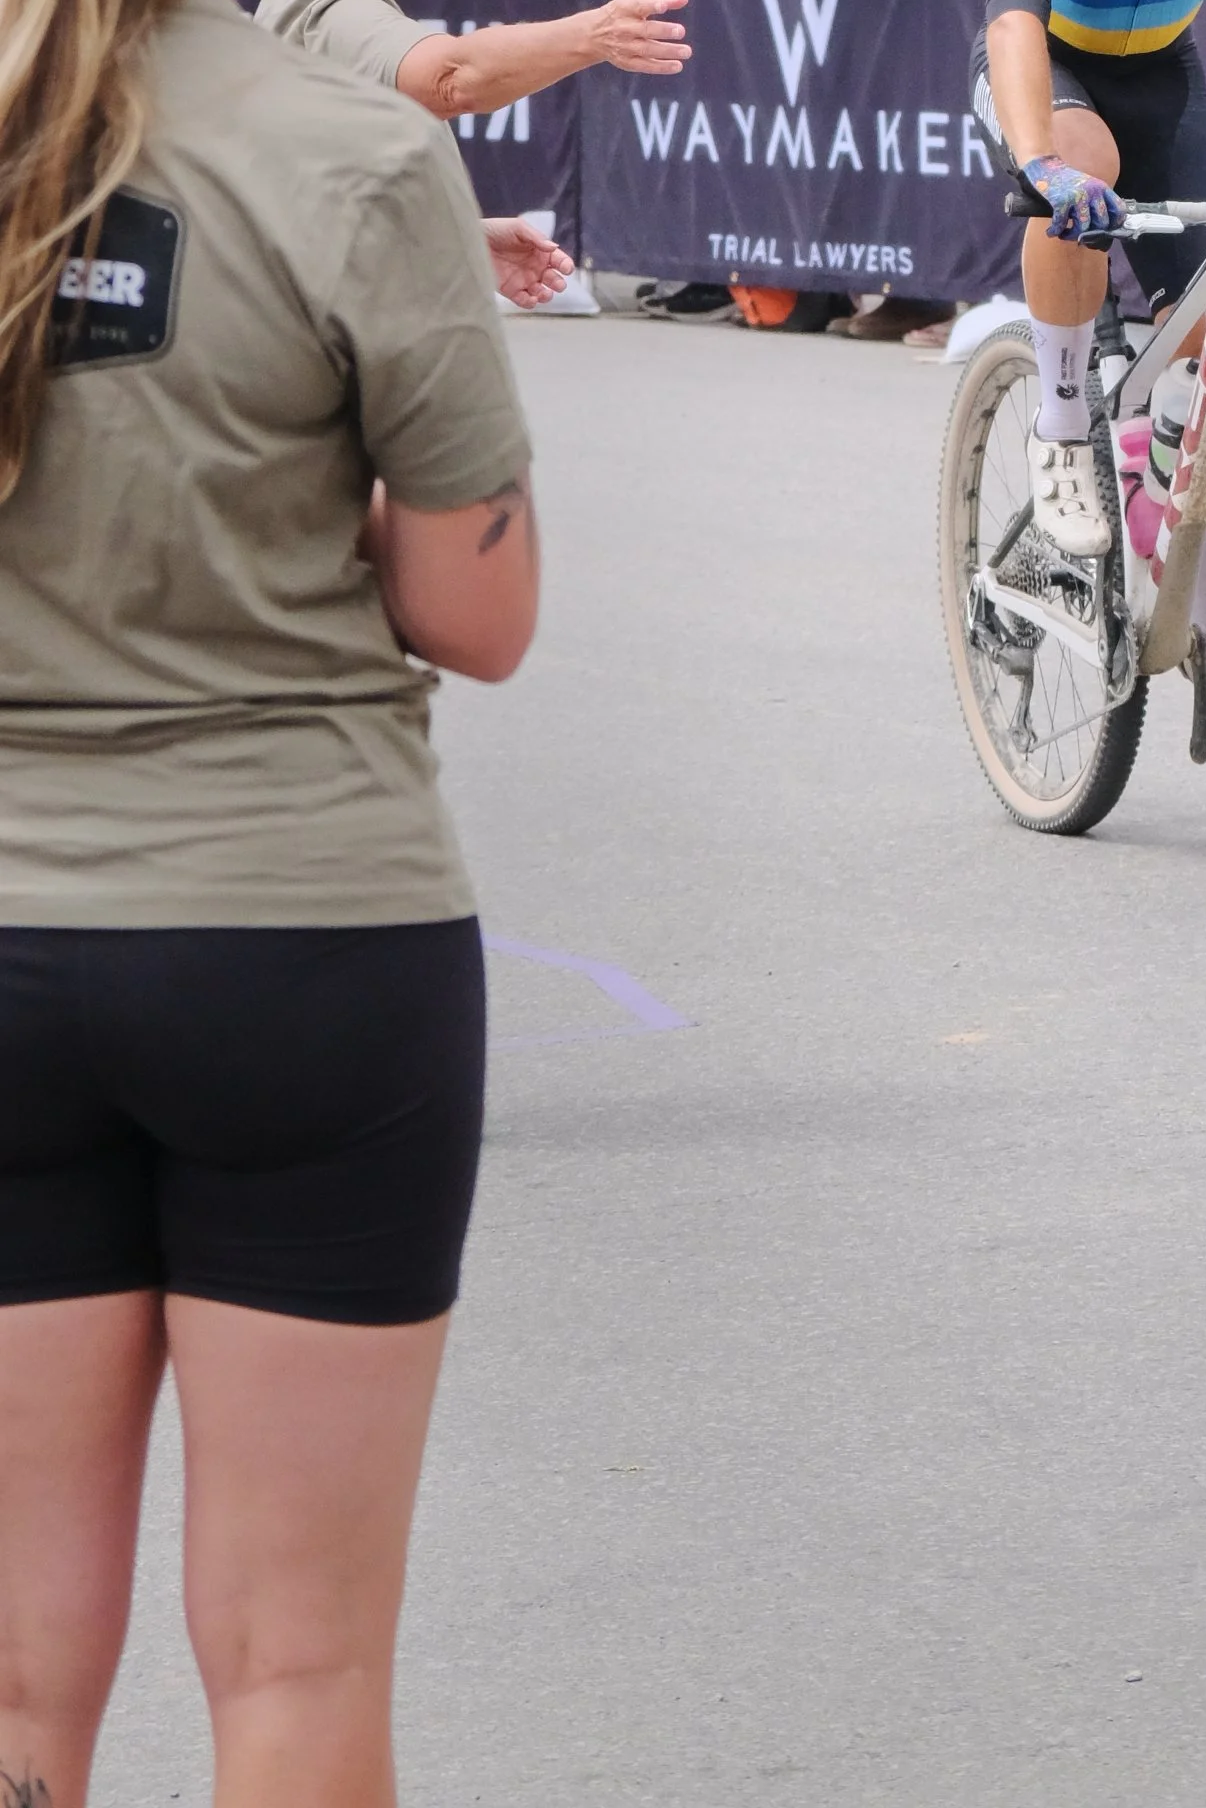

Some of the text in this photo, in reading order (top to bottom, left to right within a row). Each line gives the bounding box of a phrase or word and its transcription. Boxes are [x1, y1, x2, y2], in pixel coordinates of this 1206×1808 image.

[631, 99, 994, 179] WAYMAKER
[708, 233, 914, 275] TRIAL LAWYERS
